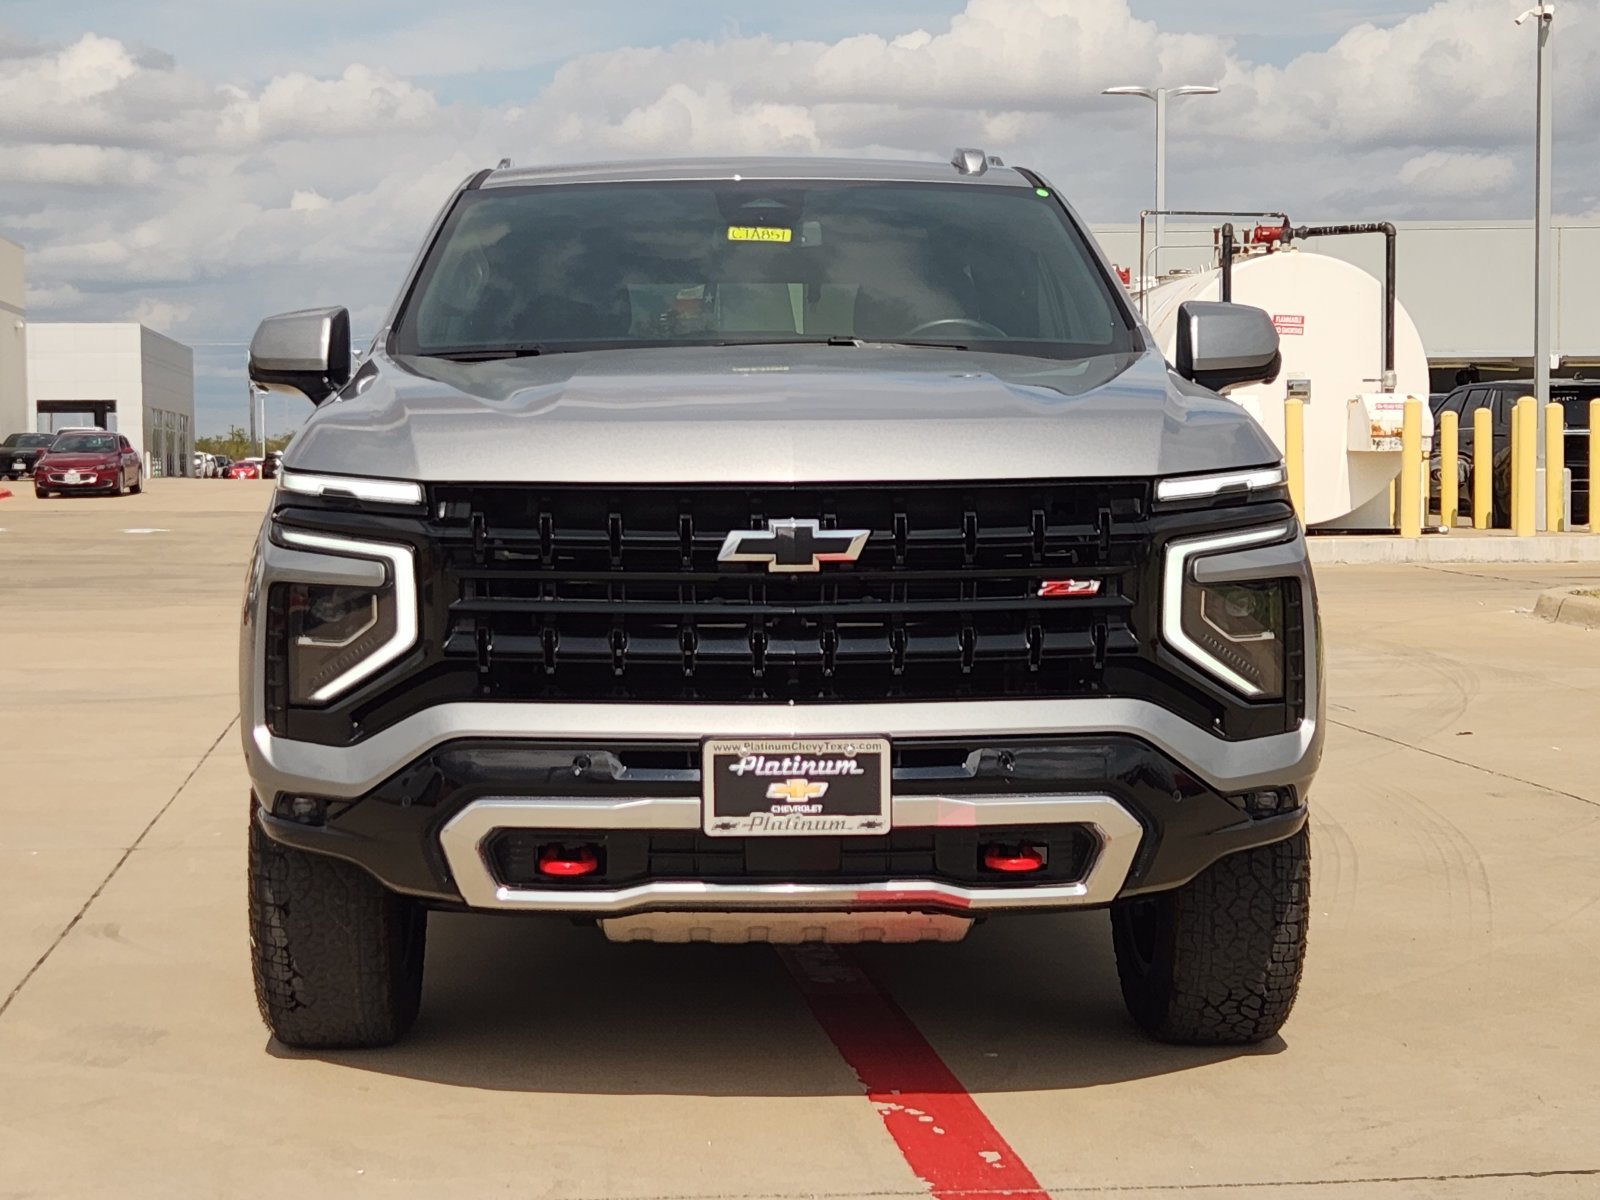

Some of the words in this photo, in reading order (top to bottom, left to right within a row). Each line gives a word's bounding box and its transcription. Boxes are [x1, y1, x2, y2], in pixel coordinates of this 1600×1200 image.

[713, 741, 882, 752] wwwPlatinumChevyTexas.com
[728, 755, 865, 777] Platinum
[770, 804, 823, 814] CHEVROLET
[742, 816, 853, 832] Platinum
